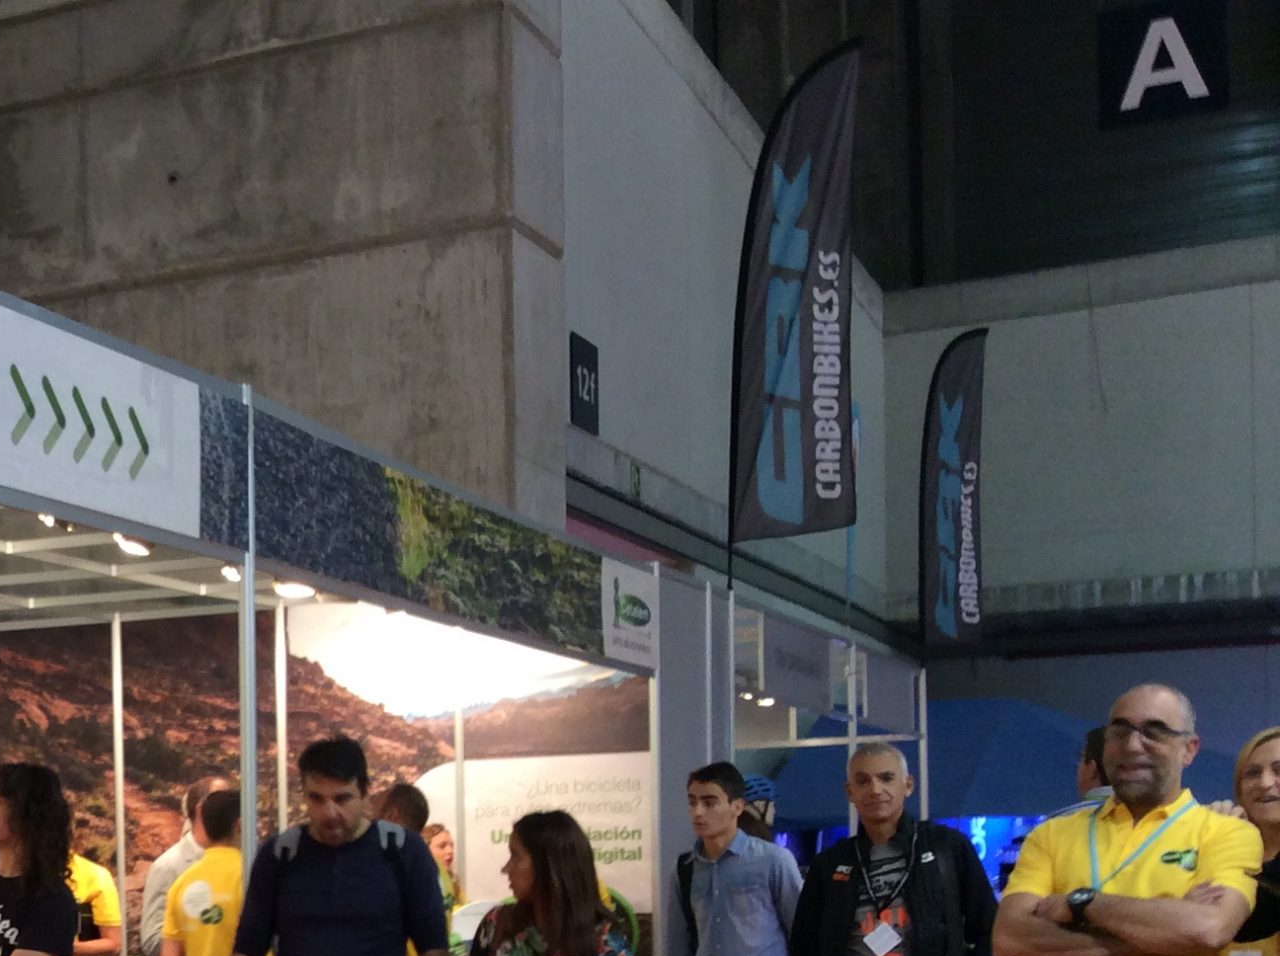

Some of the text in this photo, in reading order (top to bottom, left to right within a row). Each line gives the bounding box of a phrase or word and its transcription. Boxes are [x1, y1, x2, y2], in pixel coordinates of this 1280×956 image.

[1118, 16, 1211, 113] A
[812, 250, 842, 499] CARBONBIKES.ES
[574, 776, 641, 794] bicicleta
